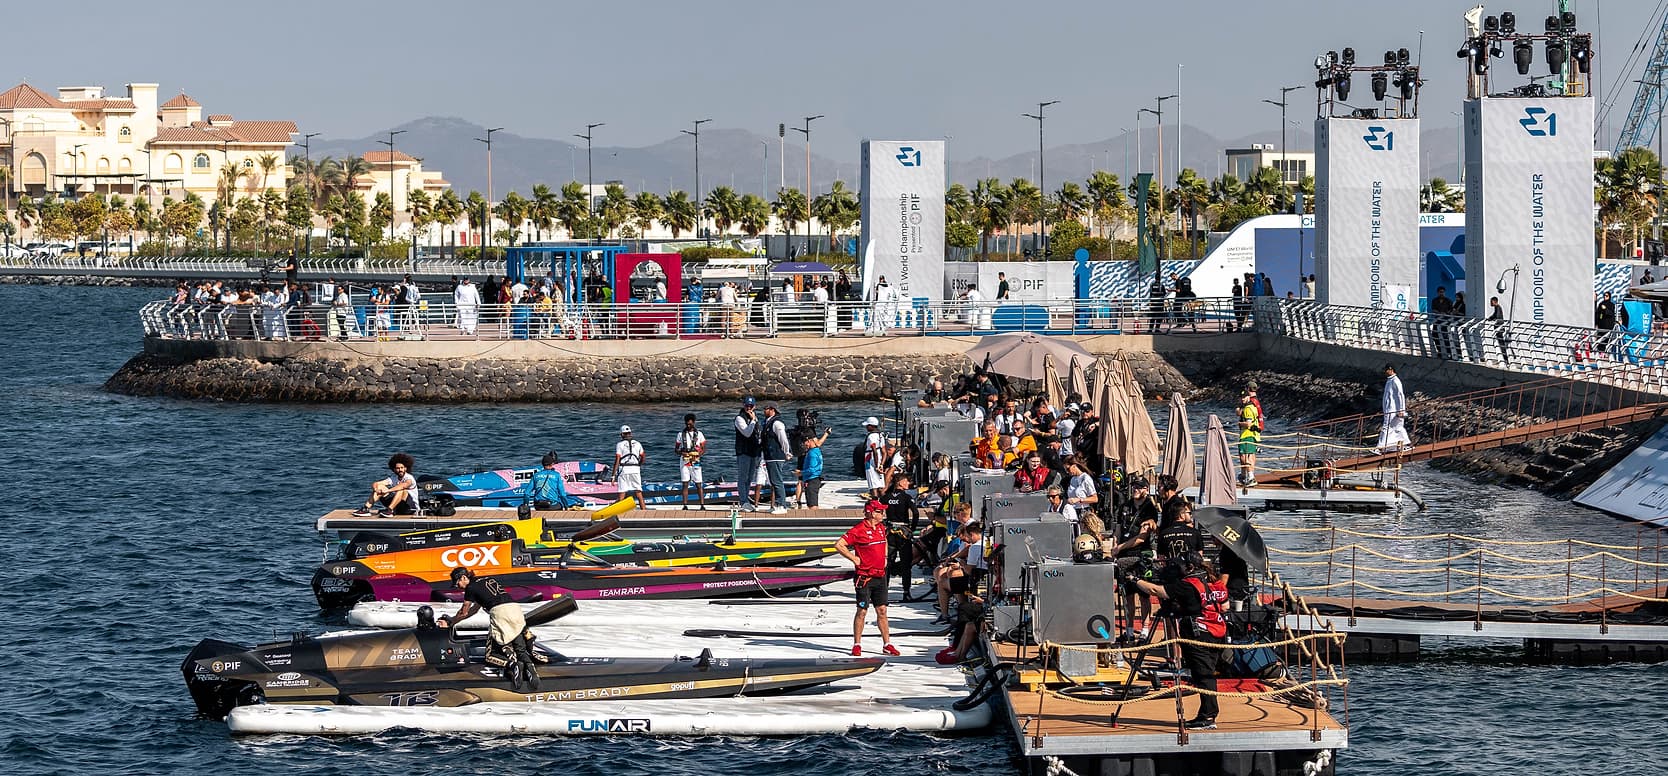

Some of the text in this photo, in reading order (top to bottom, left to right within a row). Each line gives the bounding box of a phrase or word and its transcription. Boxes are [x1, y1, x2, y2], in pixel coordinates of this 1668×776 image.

[911, 192, 920, 211] PIF
[1372, 180, 1382, 217] WATER
[1532, 173, 1543, 217] WATER
[899, 193, 908, 254] Championship
[1420, 215, 1445, 224] ATER
[1371, 220, 1380, 240] THE
[1533, 221, 1543, 246] THE
[1371, 241, 1380, 257] OF
[1533, 248, 1543, 266] OF
[899, 256, 908, 280] World
[1023, 279, 1044, 290] PIF
[1642, 313, 1650, 335] ATER
[376, 543, 389, 552] PIF
[441, 545, 500, 568] COX
[342, 566, 356, 574] PIF
[703, 581, 727, 589] PROTECT
[390, 653, 422, 661] BRADY
[392, 647, 419, 655] TEAM
[224, 661, 241, 671] PIF
[670, 681, 696, 691] gopuff
[525, 687, 630, 703] TEAM BRADY
